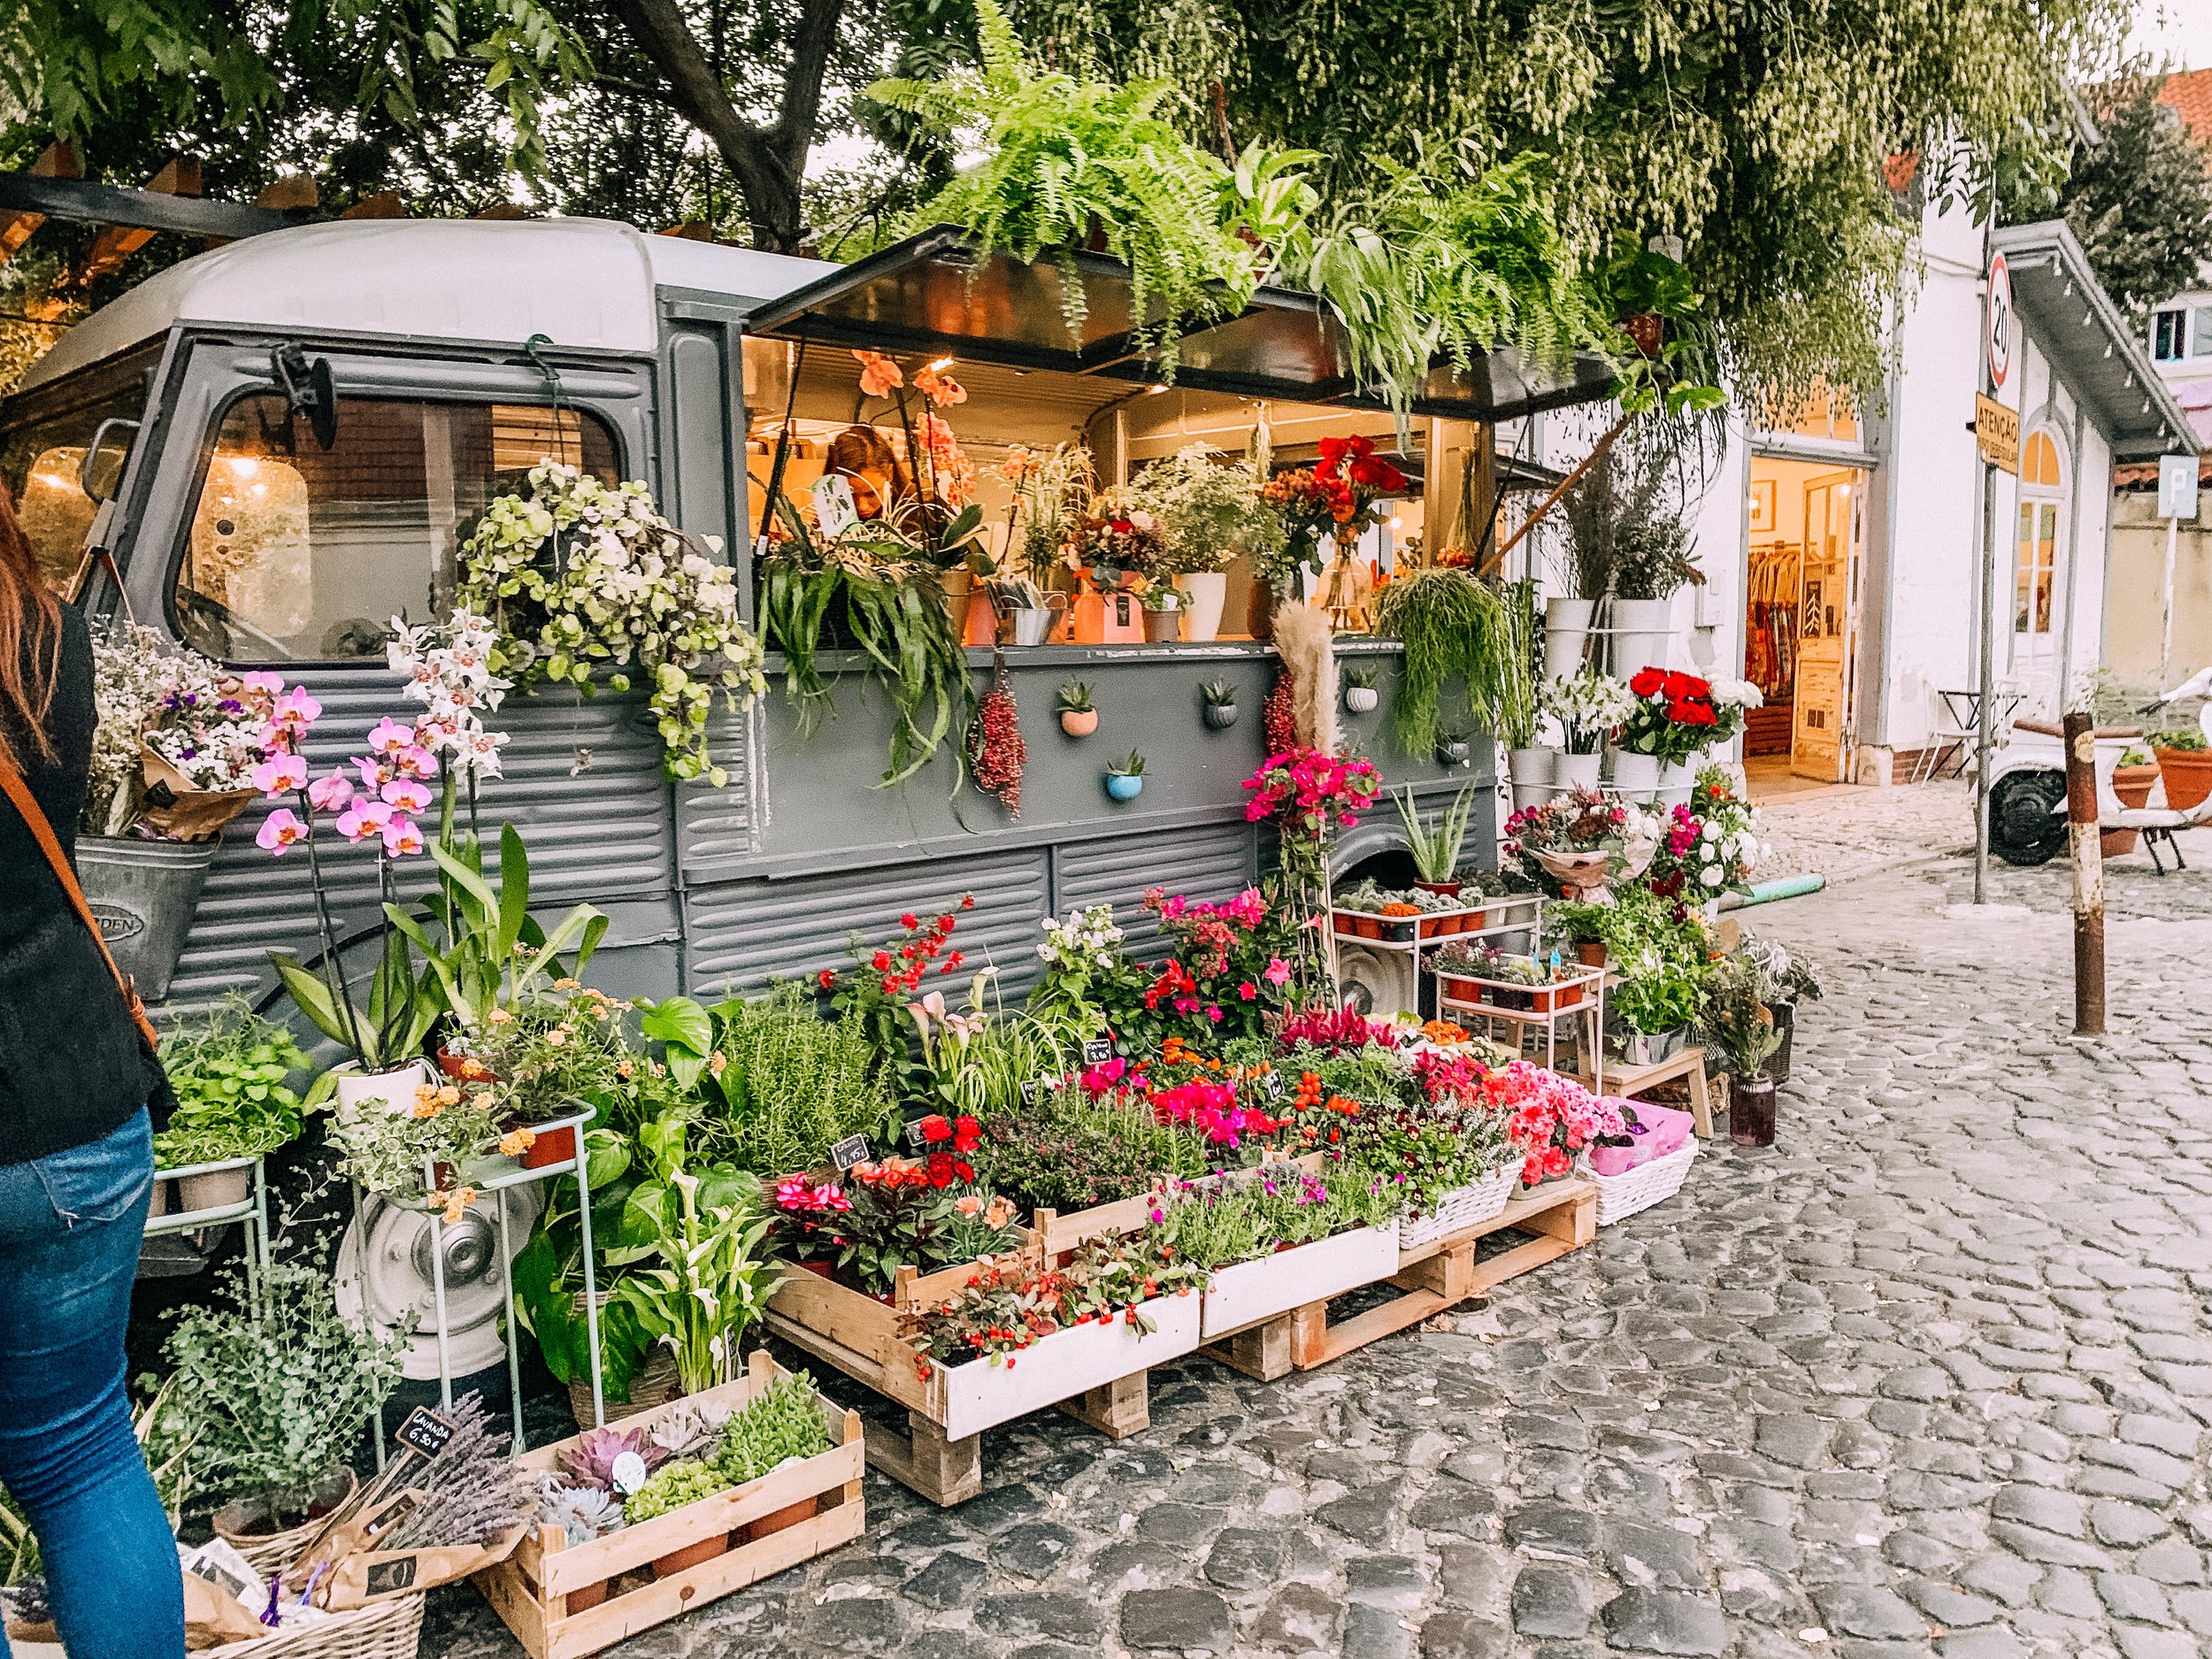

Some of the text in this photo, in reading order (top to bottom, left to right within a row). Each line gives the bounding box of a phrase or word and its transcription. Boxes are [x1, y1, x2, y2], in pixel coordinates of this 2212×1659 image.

[1993, 294, 2008, 355] 20
[1978, 407, 2017, 443] ATENÇÃO
[2170, 467, 2187, 504] P
[412, 1411, 449, 1440] LAVANDA
